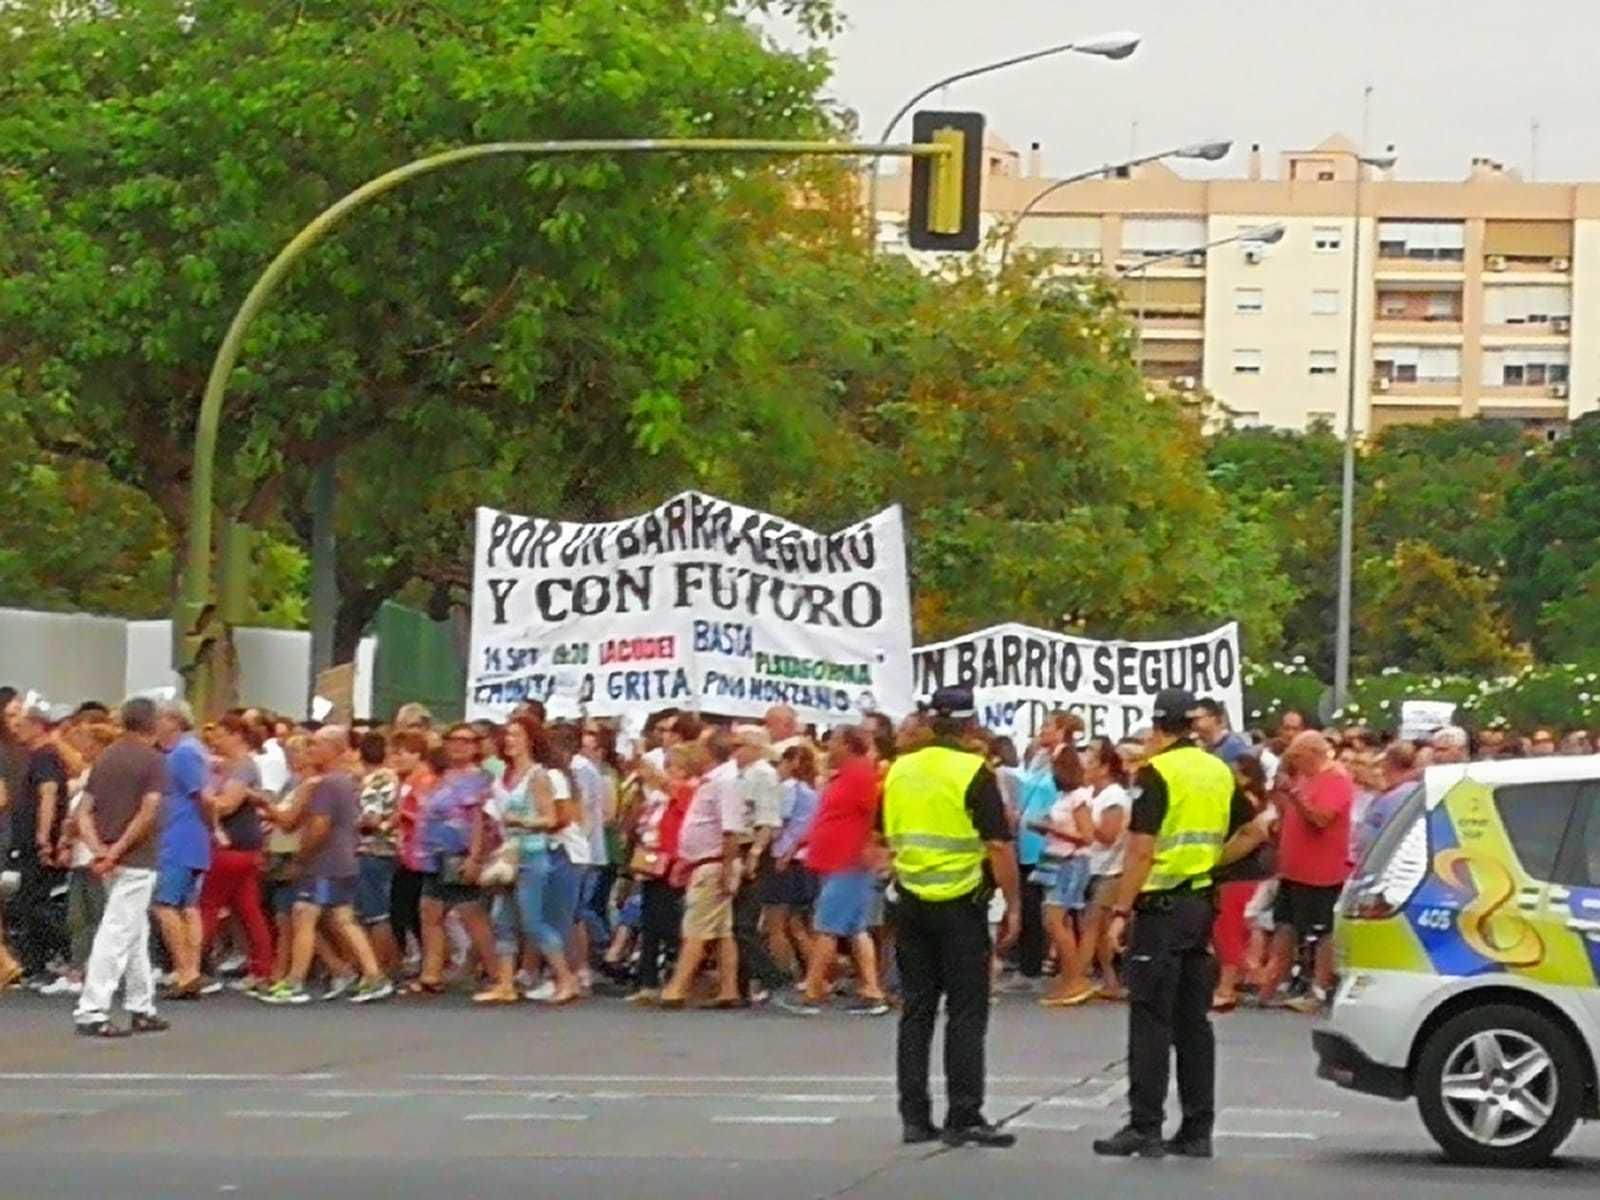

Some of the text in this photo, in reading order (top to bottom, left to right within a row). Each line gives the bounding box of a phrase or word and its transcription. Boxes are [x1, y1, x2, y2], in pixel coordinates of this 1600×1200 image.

[487, 514, 562, 568] POR
[487, 561, 883, 628] Y CON FUTURO
[693, 619, 753, 659] BASTA
[607, 667, 692, 701] GRITA
[958, 634, 1082, 691] BARRIO
[1093, 638, 1235, 695] SEGURO
[1028, 699, 1110, 739] DE
